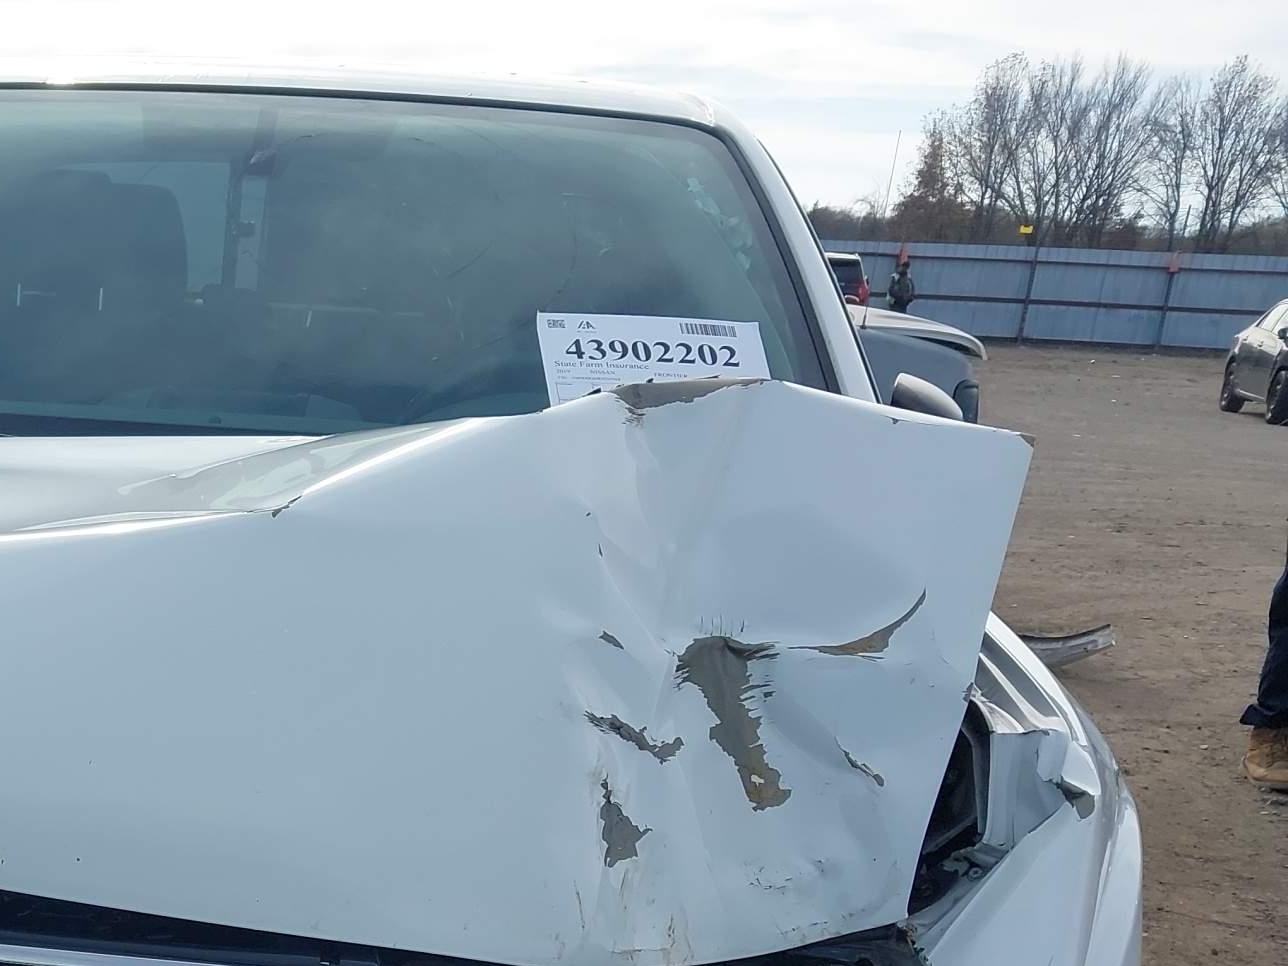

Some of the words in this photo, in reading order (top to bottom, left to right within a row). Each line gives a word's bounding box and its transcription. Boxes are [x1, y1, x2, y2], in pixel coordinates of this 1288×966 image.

[565, 338, 740, 368] 43902202
[553, 360, 578, 368] State
[579, 360, 603, 369] Farm
[605, 361, 650, 370] Insurance
